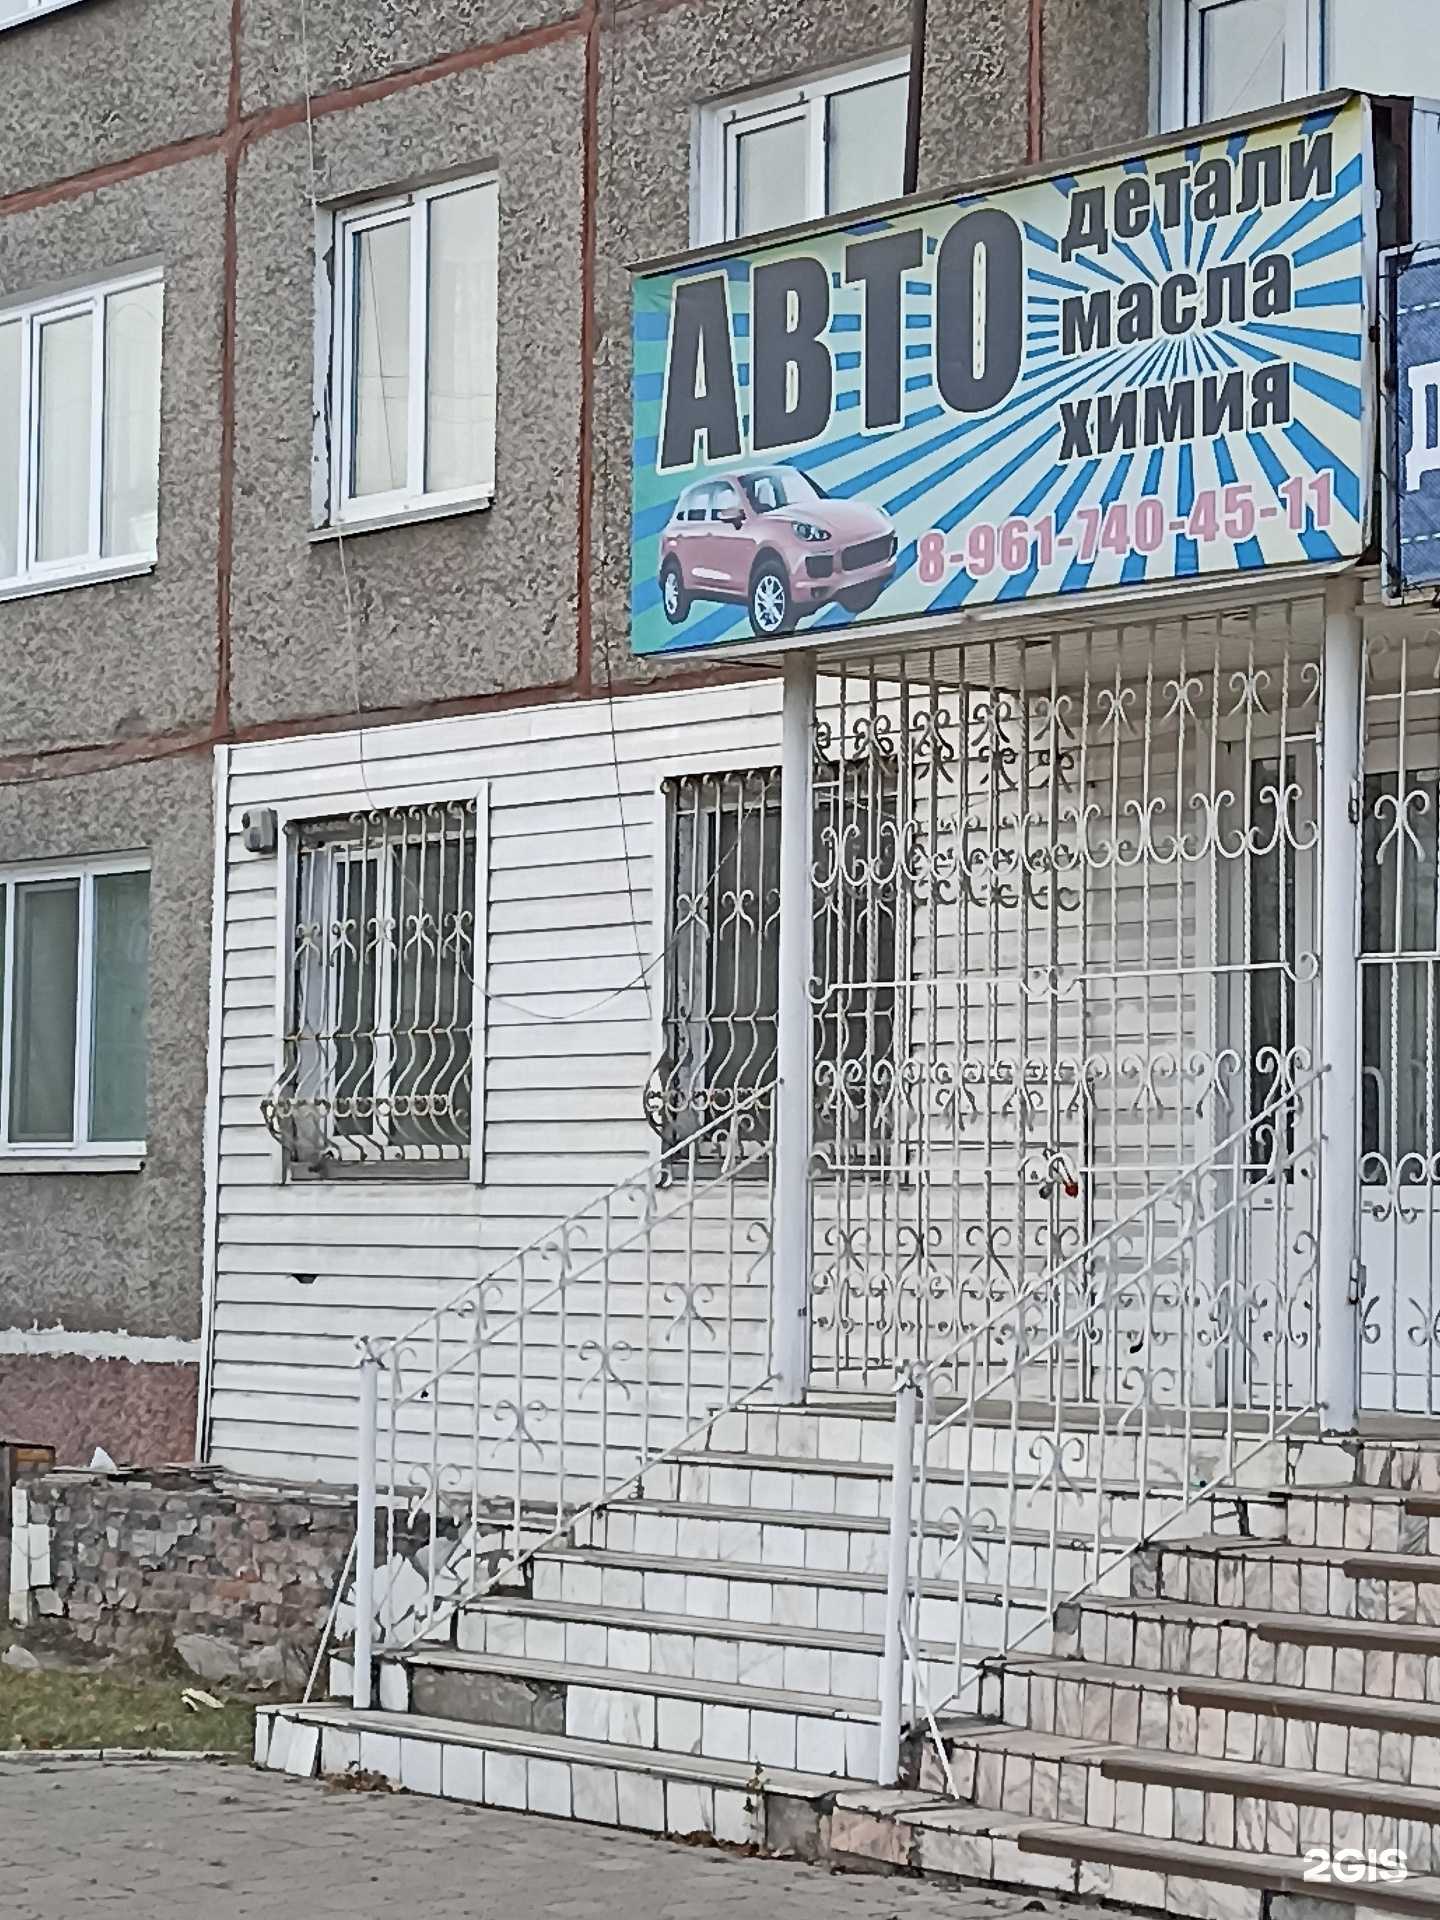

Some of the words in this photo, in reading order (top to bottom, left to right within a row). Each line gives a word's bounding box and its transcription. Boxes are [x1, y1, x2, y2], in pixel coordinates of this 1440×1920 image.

[1061, 133, 1333, 262] детали
[659, 208, 1024, 470] АВТО
[1061, 253, 1292, 356] масла
[1059, 362, 1291, 460] химия
[917, 470, 1334, 584] 8-961-740-45-11
